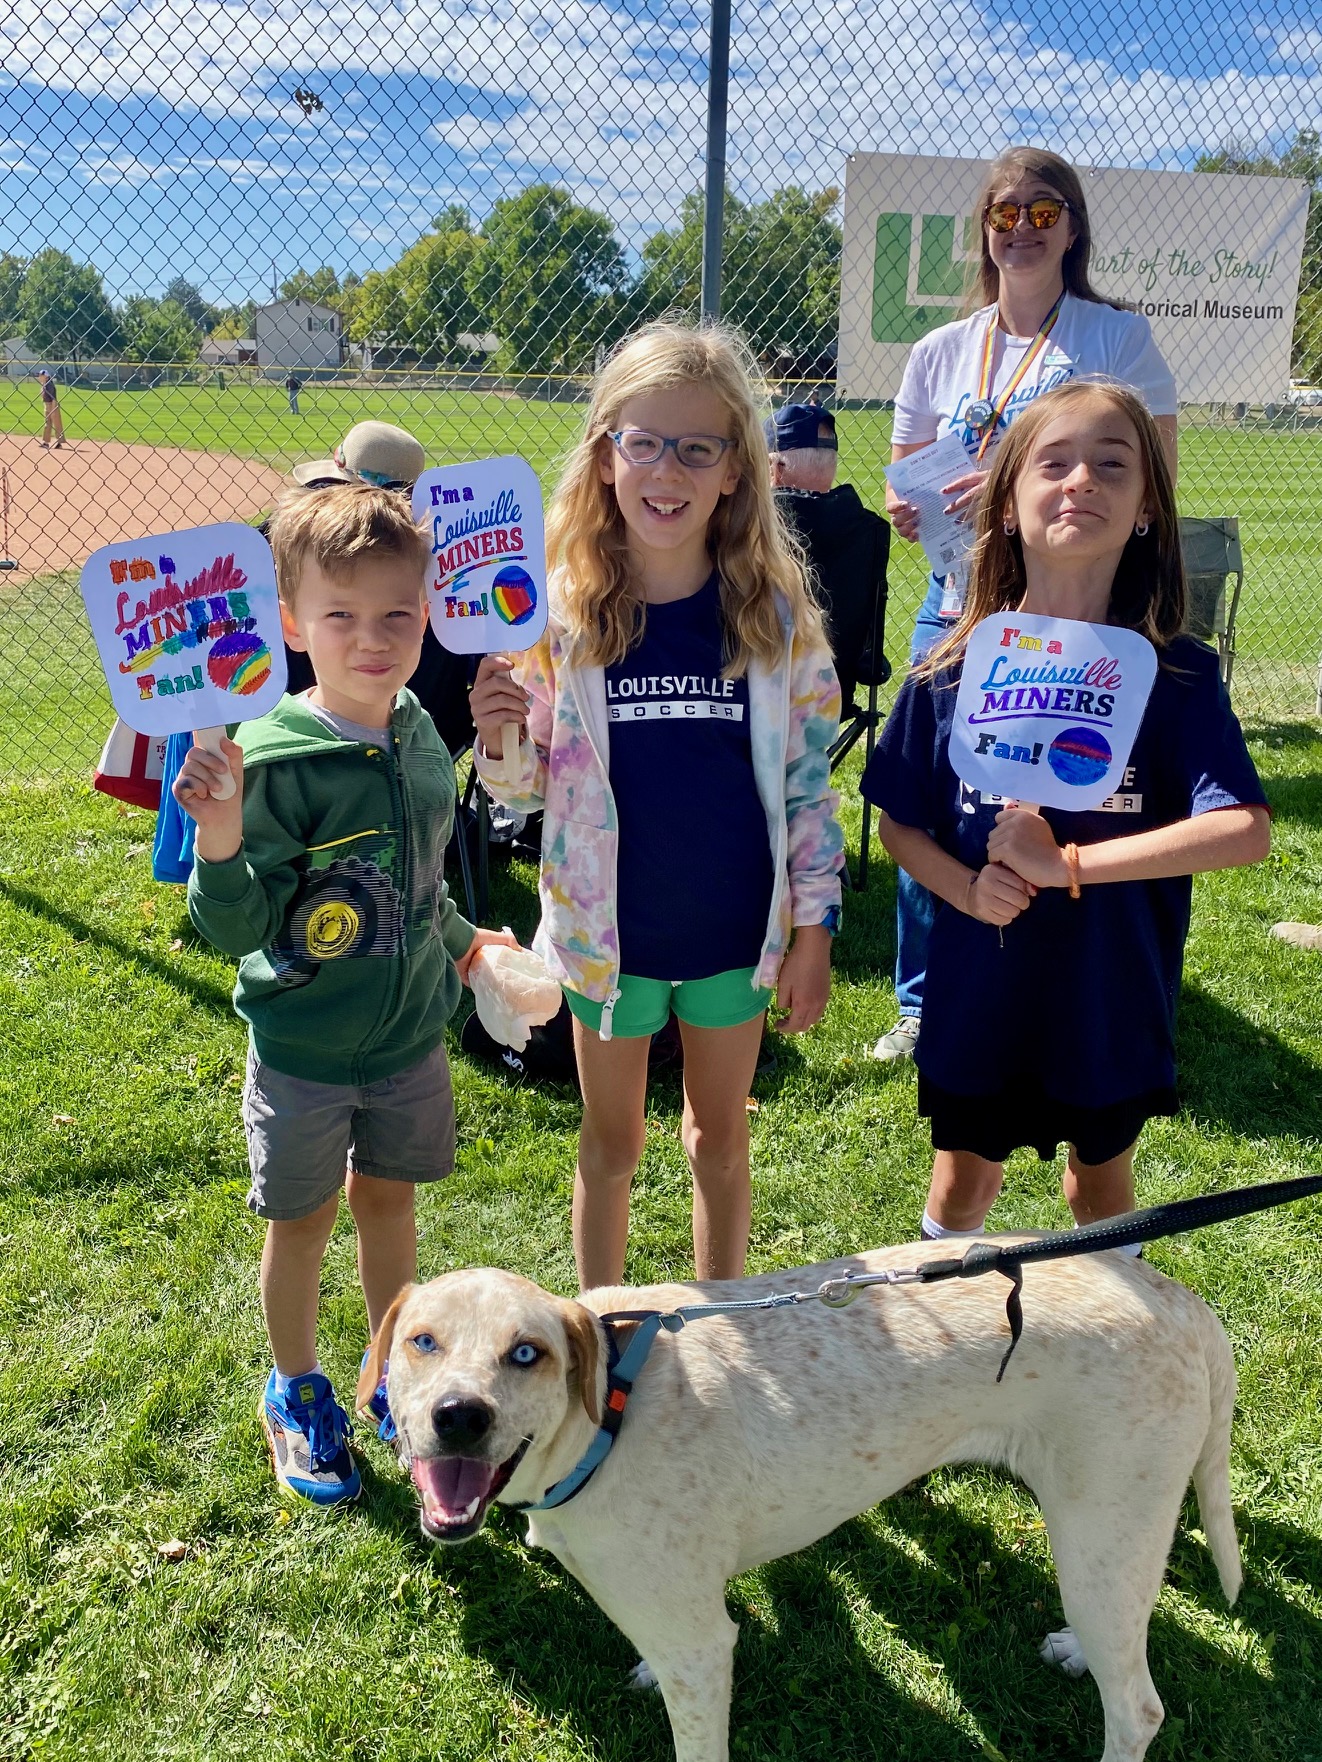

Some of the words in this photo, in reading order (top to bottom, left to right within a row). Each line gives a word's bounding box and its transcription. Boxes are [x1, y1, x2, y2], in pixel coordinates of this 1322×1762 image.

[1090, 246, 1135, 274] art
[1138, 248, 1164, 291] of
[1168, 249, 1206, 277] the
[1210, 248, 1278, 293] Story!
[1203, 300, 1283, 319] Museum
[429, 484, 460, 506] I'm
[462, 486, 474, 501] a
[431, 489, 523, 555] Louisville
[437, 527, 524, 579] MINERS
[109, 557, 156, 585] I'm
[445, 593, 489, 618] Fan!
[123, 592, 250, 661] MINERS
[1000, 628, 1042, 652] I'm
[1046, 639, 1063, 655] a
[136, 665, 205, 701] Fan!
[607, 676, 735, 698] LOUISVILLE
[980, 655, 1123, 691] Louisville
[611, 705, 734, 719] SOCCER
[979, 687, 1115, 717] MINERS
[974, 732, 1044, 765] Fan!
